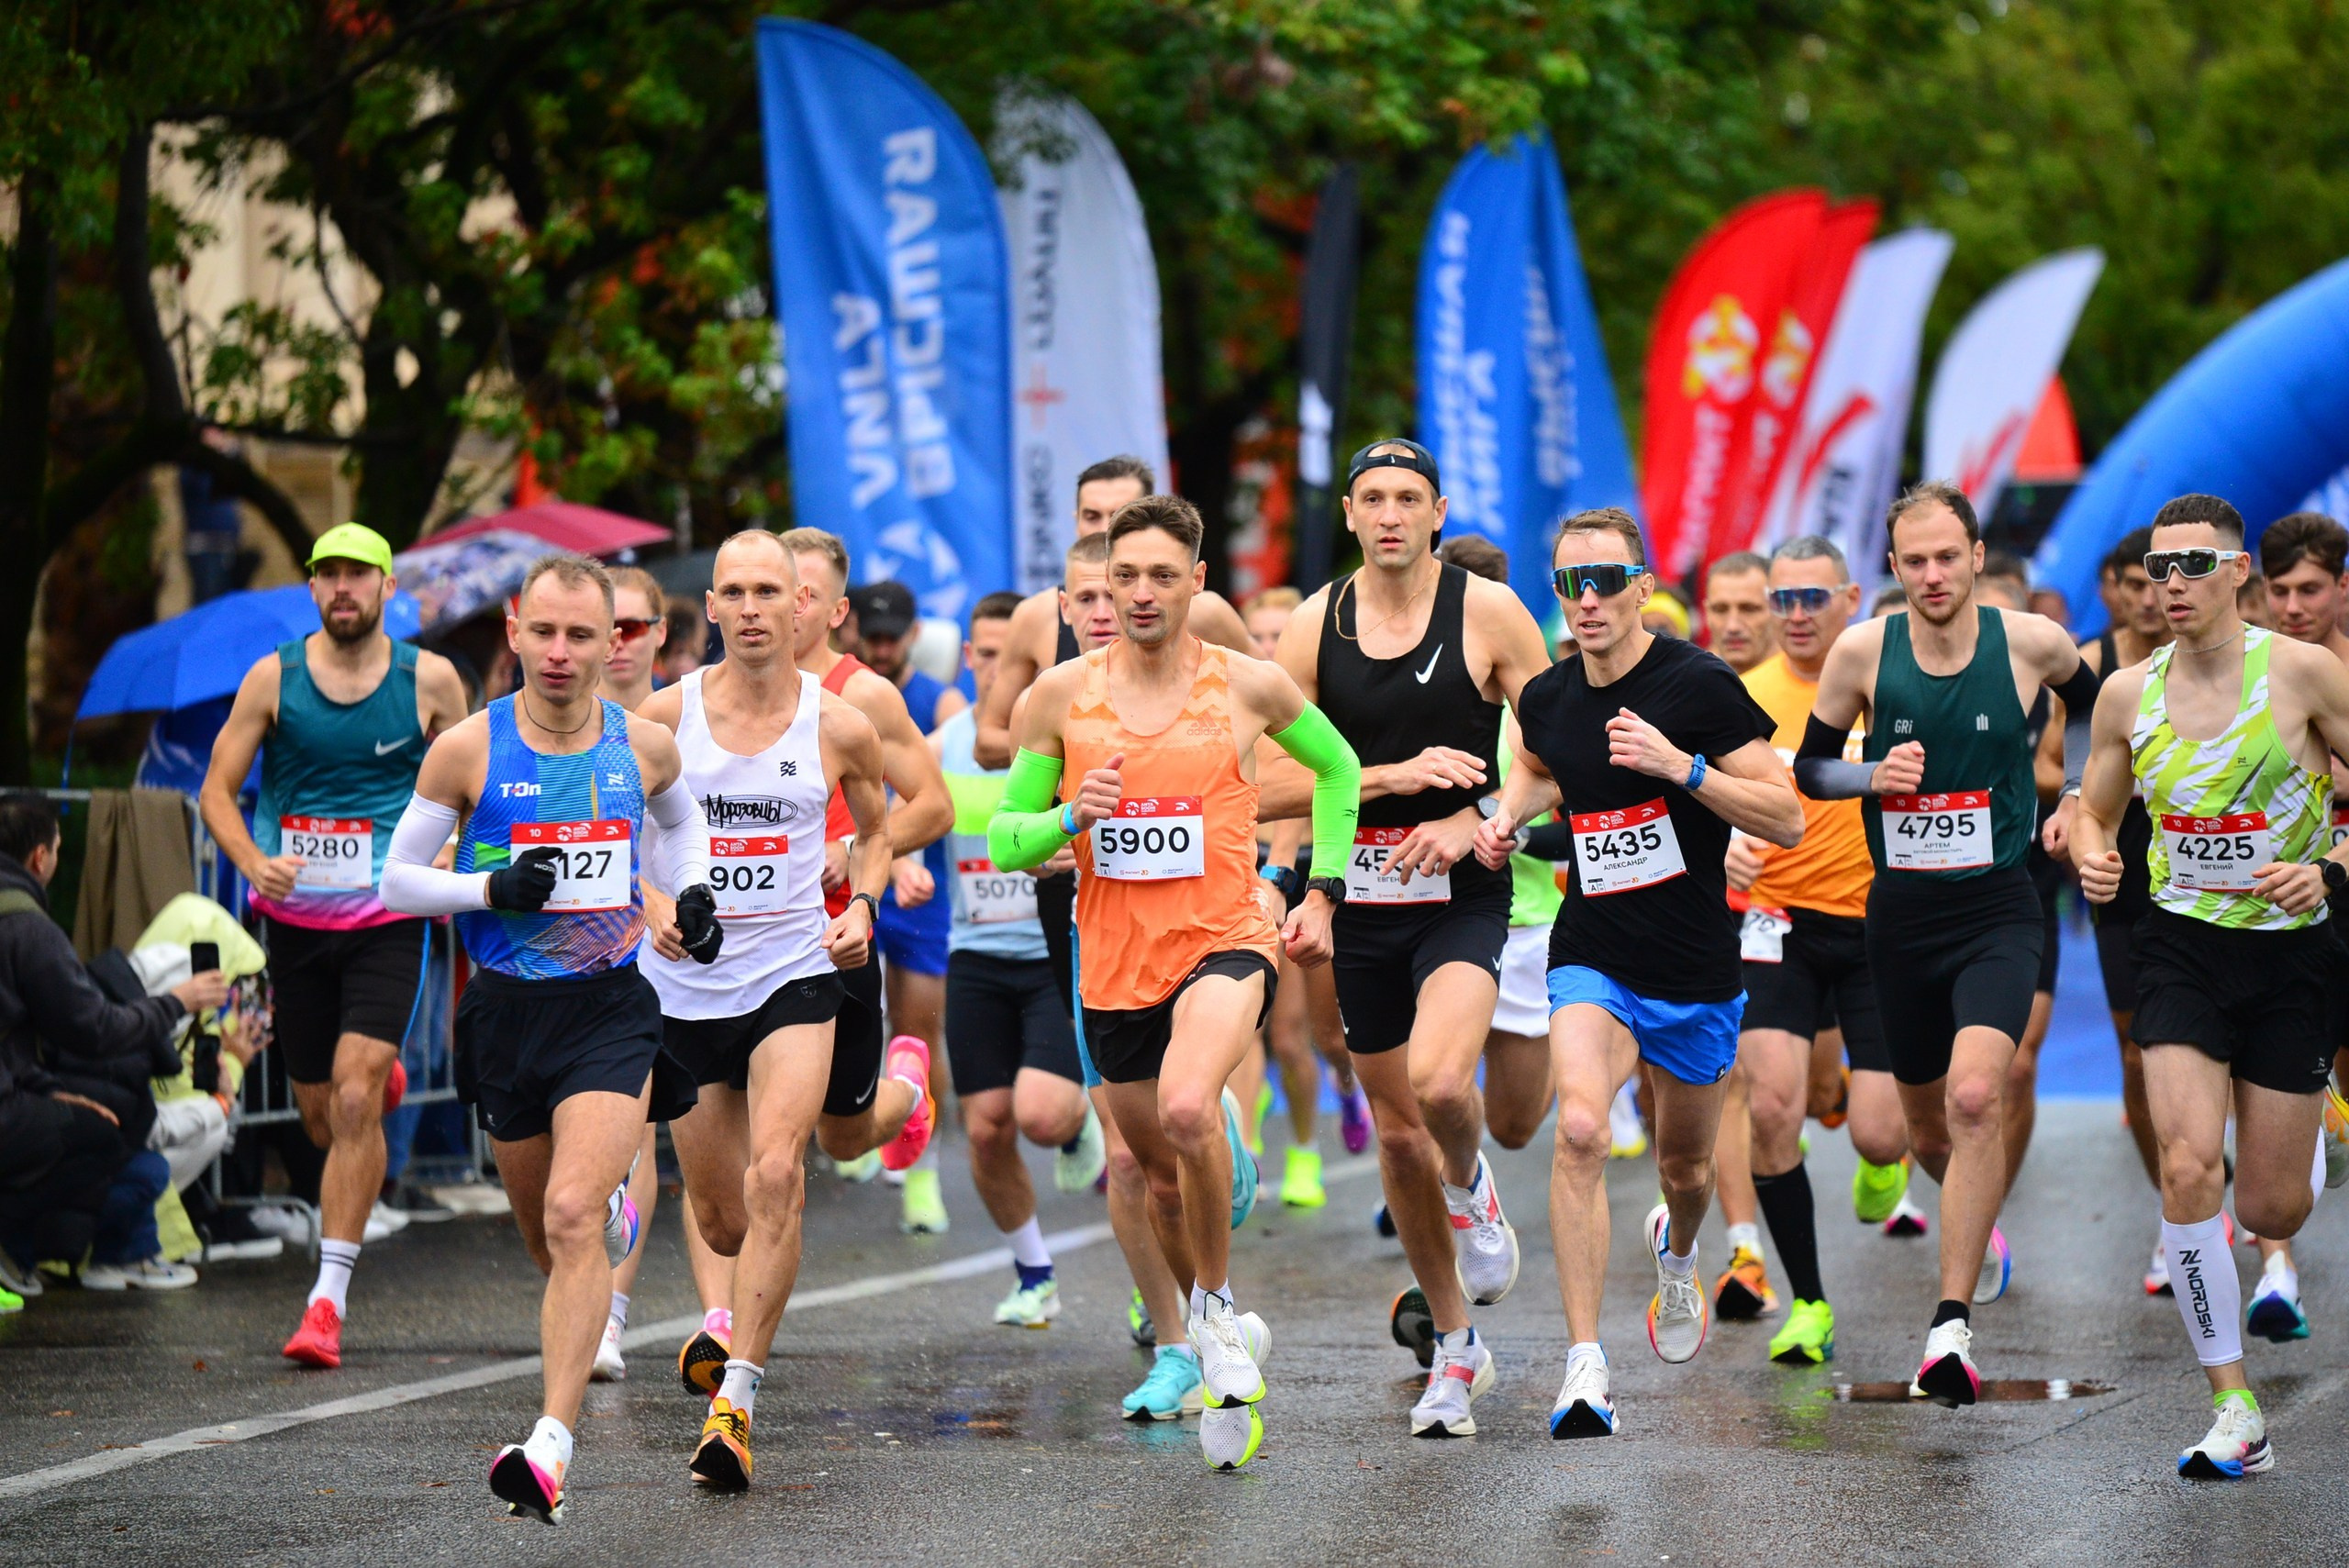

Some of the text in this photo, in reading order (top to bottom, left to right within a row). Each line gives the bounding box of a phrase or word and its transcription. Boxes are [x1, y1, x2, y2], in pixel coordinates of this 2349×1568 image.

[1186, 726, 1221, 737] adidas
[529, 828, 542, 838] 10
[1582, 818, 1589, 827] 10
[1898, 813, 1976, 840] 4795
[2173, 819, 2182, 828] 10
[293, 834, 359, 859] 5280
[1100, 827, 1189, 854] 5900
[1585, 824, 1662, 862] 5435
[2176, 835, 2254, 861] 4225
[1603, 856, 1649, 871] АЛЕКСАНДР
[2200, 862, 2234, 871] ЕВГЕНИЙ
[975, 878, 1035, 899] 5070
[2185, 1266, 2216, 1339] NORDSKI
